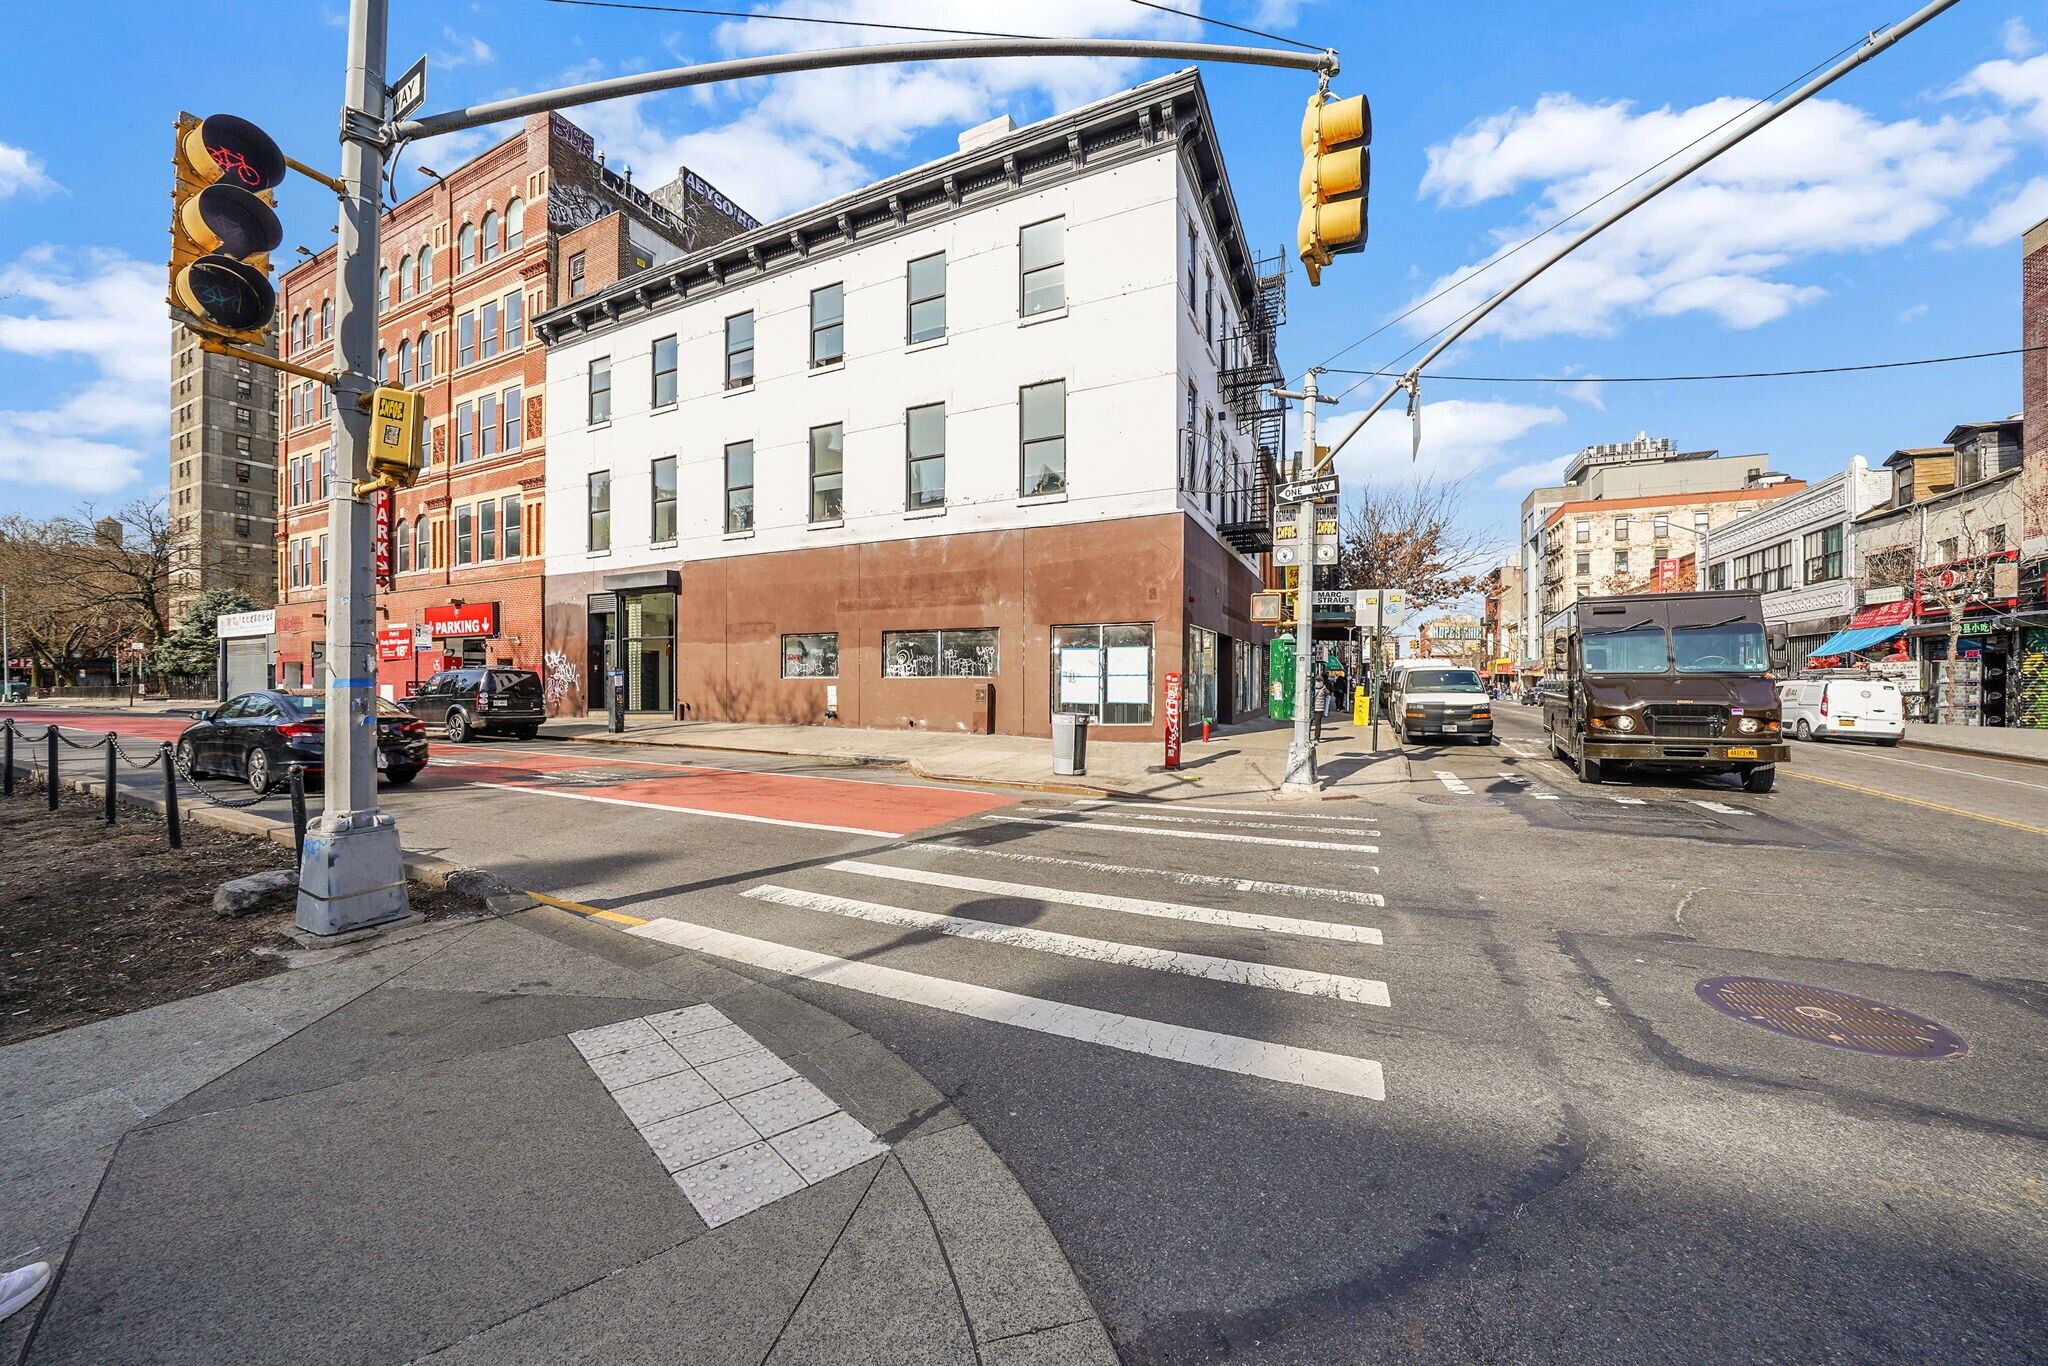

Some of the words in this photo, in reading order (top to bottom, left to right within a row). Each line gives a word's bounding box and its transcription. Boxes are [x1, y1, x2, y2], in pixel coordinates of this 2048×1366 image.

[394, 80, 416, 112] WAY
[1284, 487, 1303, 498] ONE
[1311, 482, 1331, 492] WAY
[377, 490, 389, 557] PARK
[435, 619, 480, 635] PARKING
